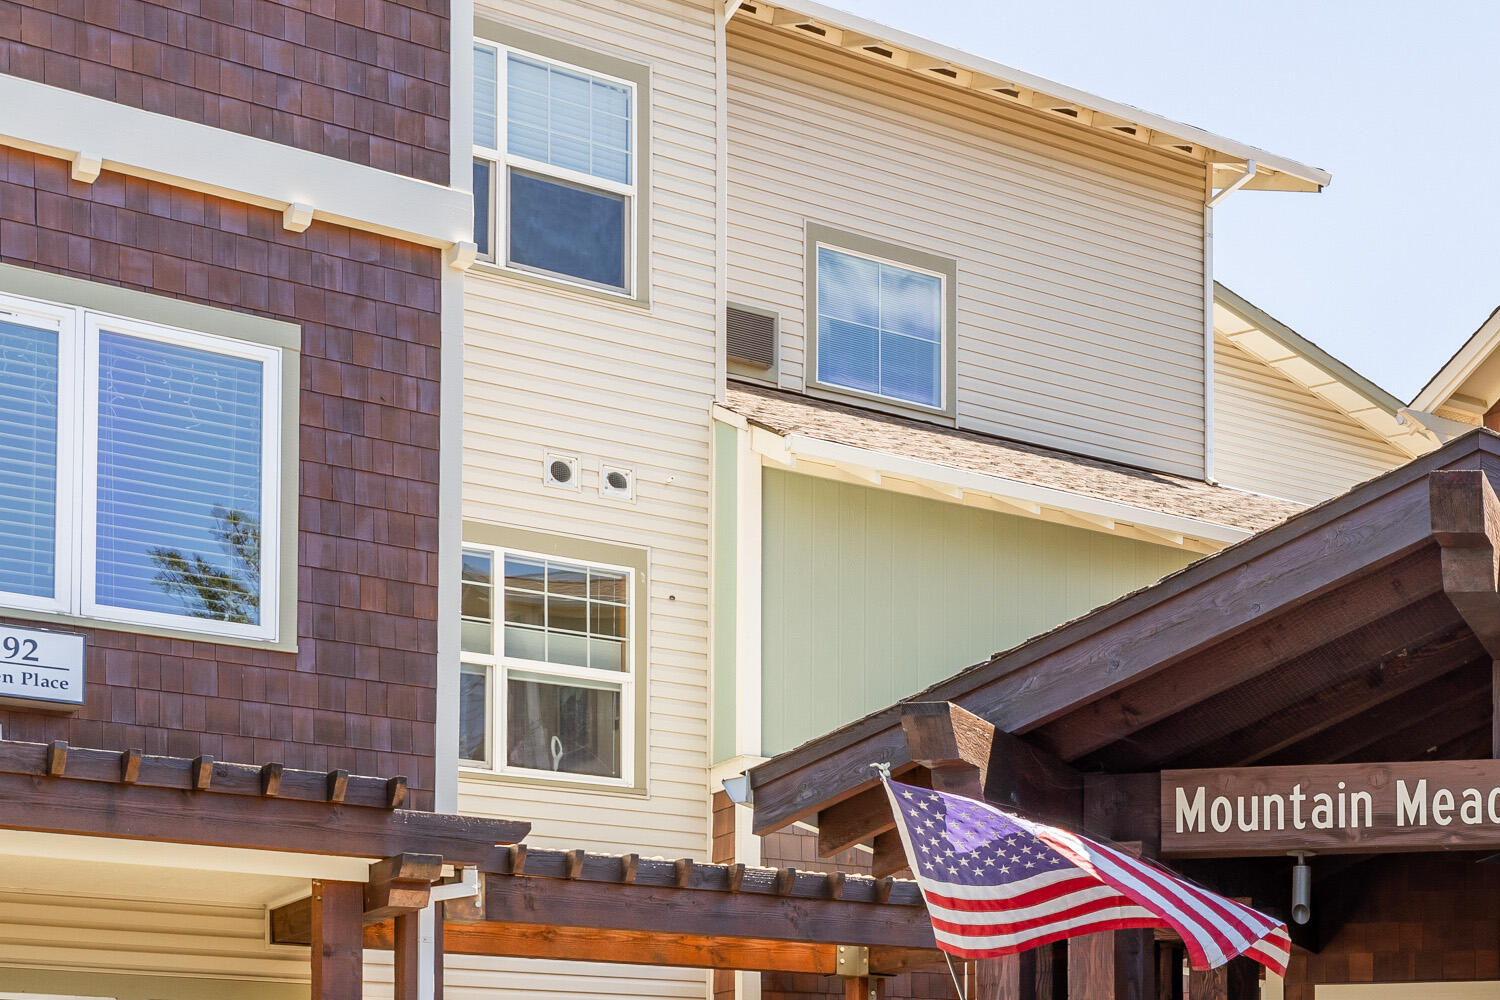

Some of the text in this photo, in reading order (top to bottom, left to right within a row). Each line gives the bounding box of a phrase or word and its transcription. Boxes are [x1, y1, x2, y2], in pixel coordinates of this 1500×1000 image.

[3, 636, 39, 661] 92
[0, 671, 69, 690] n Place
[1175, 782, 1373, 834] Mountain
